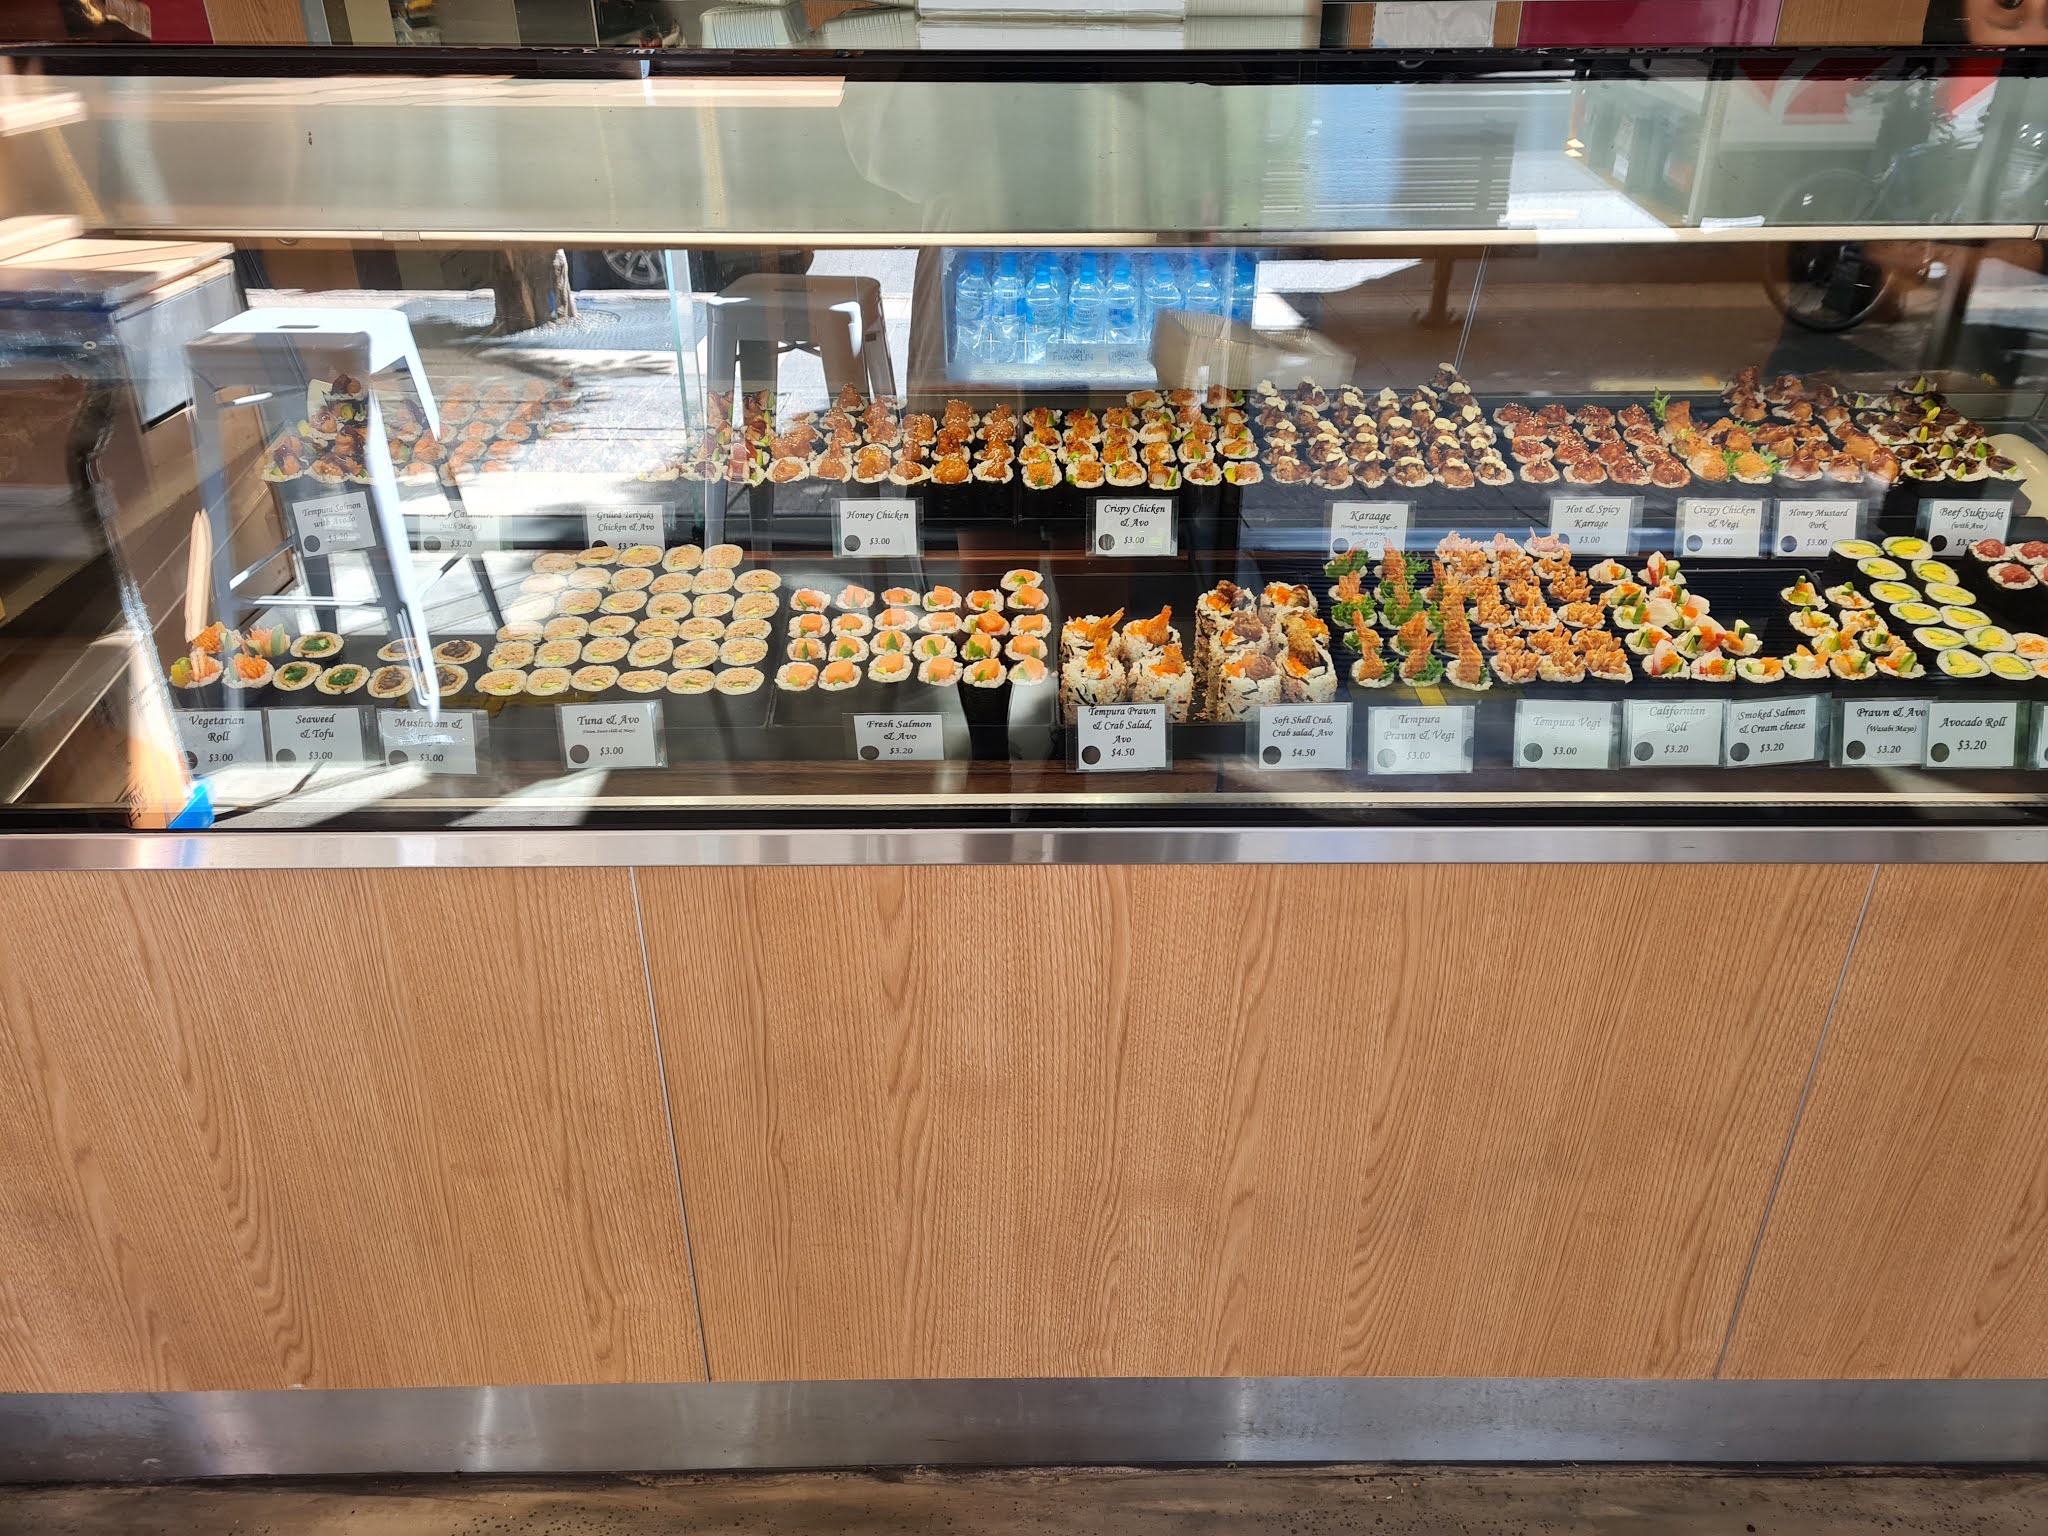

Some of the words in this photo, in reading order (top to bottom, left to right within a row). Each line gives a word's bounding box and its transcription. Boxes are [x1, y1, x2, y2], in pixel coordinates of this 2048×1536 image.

[1052, 351, 1094, 361] FRANKLIN
[302, 508, 333, 517] Tempura
[335, 502, 361, 513] Salmon
[1104, 503, 1130, 515] Crispy
[1132, 503, 1166, 515] Chicken
[1565, 504, 1582, 514] Hot
[1585, 504, 1595, 514] &
[1596, 504, 1621, 516] Spicy
[1693, 505, 1720, 516] Crispy
[1722, 504, 1756, 516] Chicken
[1788, 508, 1814, 519] Honey
[1814, 508, 1850, 517] Mustard
[1940, 507, 1964, 519] Beef
[1962, 507, 2005, 520] Sukiyaki
[623, 510, 654, 520] Teriyaki
[846, 510, 874, 521] Honey
[876, 509, 909, 521] Chicken
[1350, 510, 1392, 524] Karaage
[313, 517, 331, 527] with
[598, 522, 627, 532] Chicken
[629, 522, 638, 531] &
[638, 523, 655, 532] Avo
[1120, 517, 1130, 527] &
[1130, 518, 1149, 528] Avo
[1574, 519, 1608, 530] Karrage
[1708, 518, 1718, 528] &
[1719, 519, 1740, 530] Vegi
[1808, 521, 1828, 530] Pork
[1951, 521, 1969, 530] (with
[328, 533, 348, 543] $3.20
[869, 537, 891, 546] $3.00
[1124, 536, 1145, 545] $3.00
[1579, 536, 1600, 545] $3.00
[1711, 537, 1733, 546] $3.00
[1806, 538, 1828, 546] $3.00
[450, 539, 472, 548] $3.20
[1088, 707, 1125, 718] Tempura
[1127, 707, 1157, 715] Prawn
[1650, 705, 1706, 718] Californian
[1738, 708, 1774, 720] Smoked
[1774, 707, 1806, 718] Salmon
[1856, 708, 1889, 717] Prawn
[1893, 707, 1904, 717] &
[1904, 707, 1927, 718] Avo
[189, 715, 245, 729] Vegetarian
[295, 714, 336, 725] Seaweed
[394, 718, 448, 728] Mushroom
[451, 718, 463, 729] &
[577, 715, 603, 726] Tuna
[606, 714, 617, 725] &
[618, 714, 640, 725] Avo
[866, 720, 893, 728] Fresh
[895, 719, 932, 729] Salmon
[1272, 715, 1290, 726] Soft
[1290, 715, 1312, 725] Shell
[1313, 715, 1333, 725] Crab,
[1398, 714, 1441, 726] Tempura
[1533, 716, 1575, 730] Tempura
[1578, 716, 1602, 731] Vegi
[1939, 716, 1982, 728] Avocado
[1984, 716, 2008, 728] Roll
[1092, 721, 1102, 730] &
[1104, 720, 1124, 730] Crab
[1126, 720, 1152, 730] Salad,
[1666, 721, 1689, 734] Roll
[1739, 724, 1750, 734] &
[1751, 724, 1778, 734] Cream
[1779, 721, 1806, 731] cheese
[1866, 723, 1894, 734] (Wasabi
[1895, 725, 1917, 734] Mayo)
[207, 731, 231, 743] Roll
[300, 729, 311, 739] &
[312, 729, 334, 741] Tofu
[883, 731, 895, 740] &
[895, 732, 917, 740] Avo
[1272, 728, 1291, 738] Crab
[1292, 728, 1315, 738] salad,
[1315, 729, 1334, 738] Avo
[1383, 731, 1416, 740] Prawn
[1419, 730, 1430, 740] &
[1432, 730, 1456, 743] Vegi
[1112, 735, 1132, 744] Avo
[600, 746, 624, 756] $3.00
[889, 747, 913, 755] $3.20
[1553, 746, 1577, 756] $3.00
[1664, 745, 1689, 754] $3.20
[1760, 743, 1784, 753] $3.20
[1877, 745, 1901, 754] $3.20
[1957, 740, 1987, 752] $3.20
[308, 751, 333, 761] $3.00
[419, 753, 444, 762] $3.00
[1111, 748, 1135, 757] $4.50
[1292, 748, 1316, 757] $4.50
[1407, 751, 1431, 760] $3.00
[208, 753, 234, 763] $3.00
